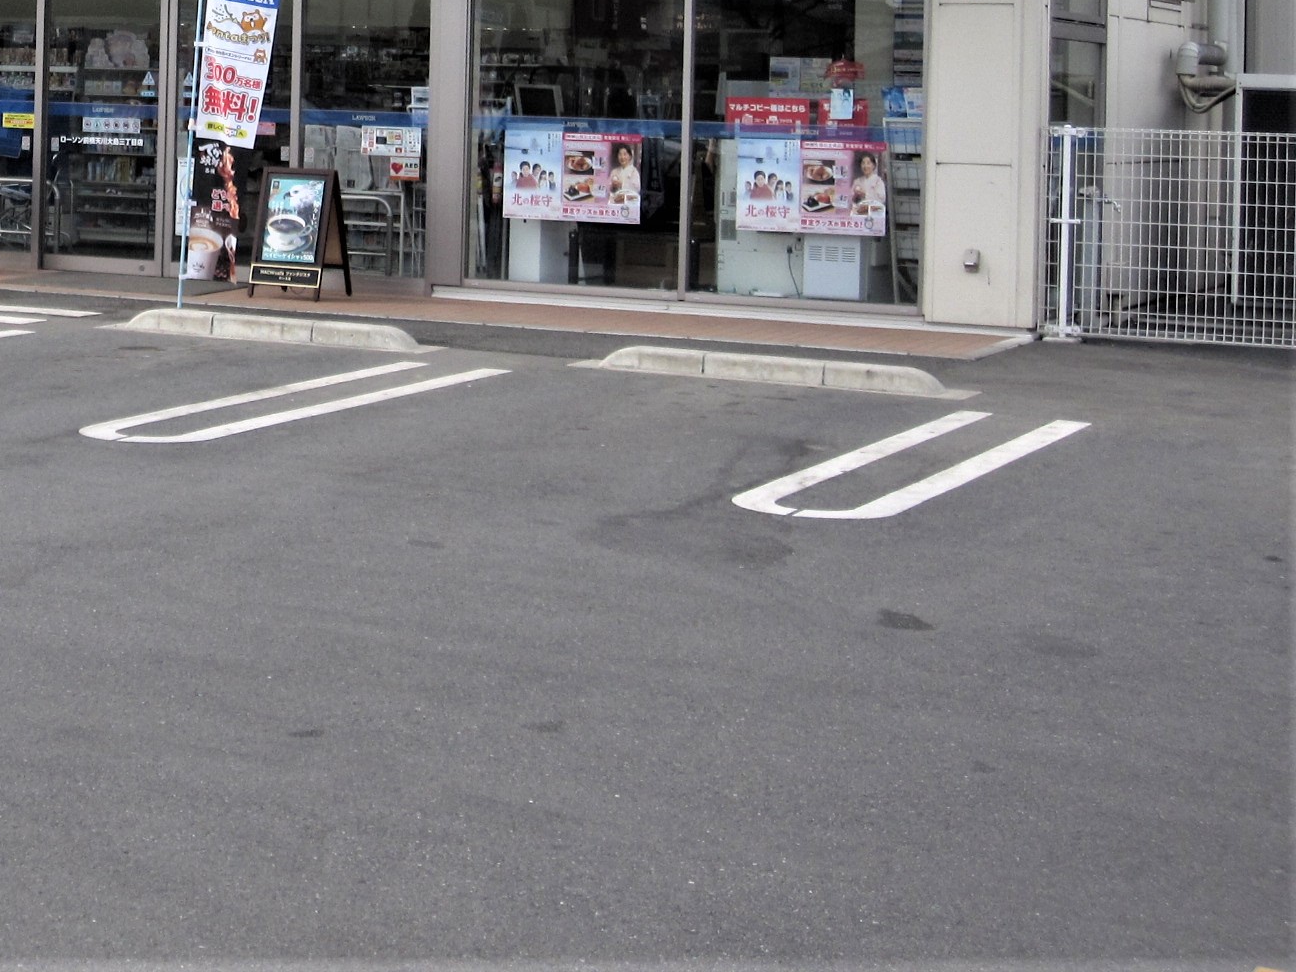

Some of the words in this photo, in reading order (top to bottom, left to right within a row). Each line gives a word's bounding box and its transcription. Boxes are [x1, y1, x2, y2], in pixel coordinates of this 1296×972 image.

[202, 84, 260, 123] 無料!
[511, 193, 553, 207] 北の桜守
[745, 204, 791, 219] 北の桜守
